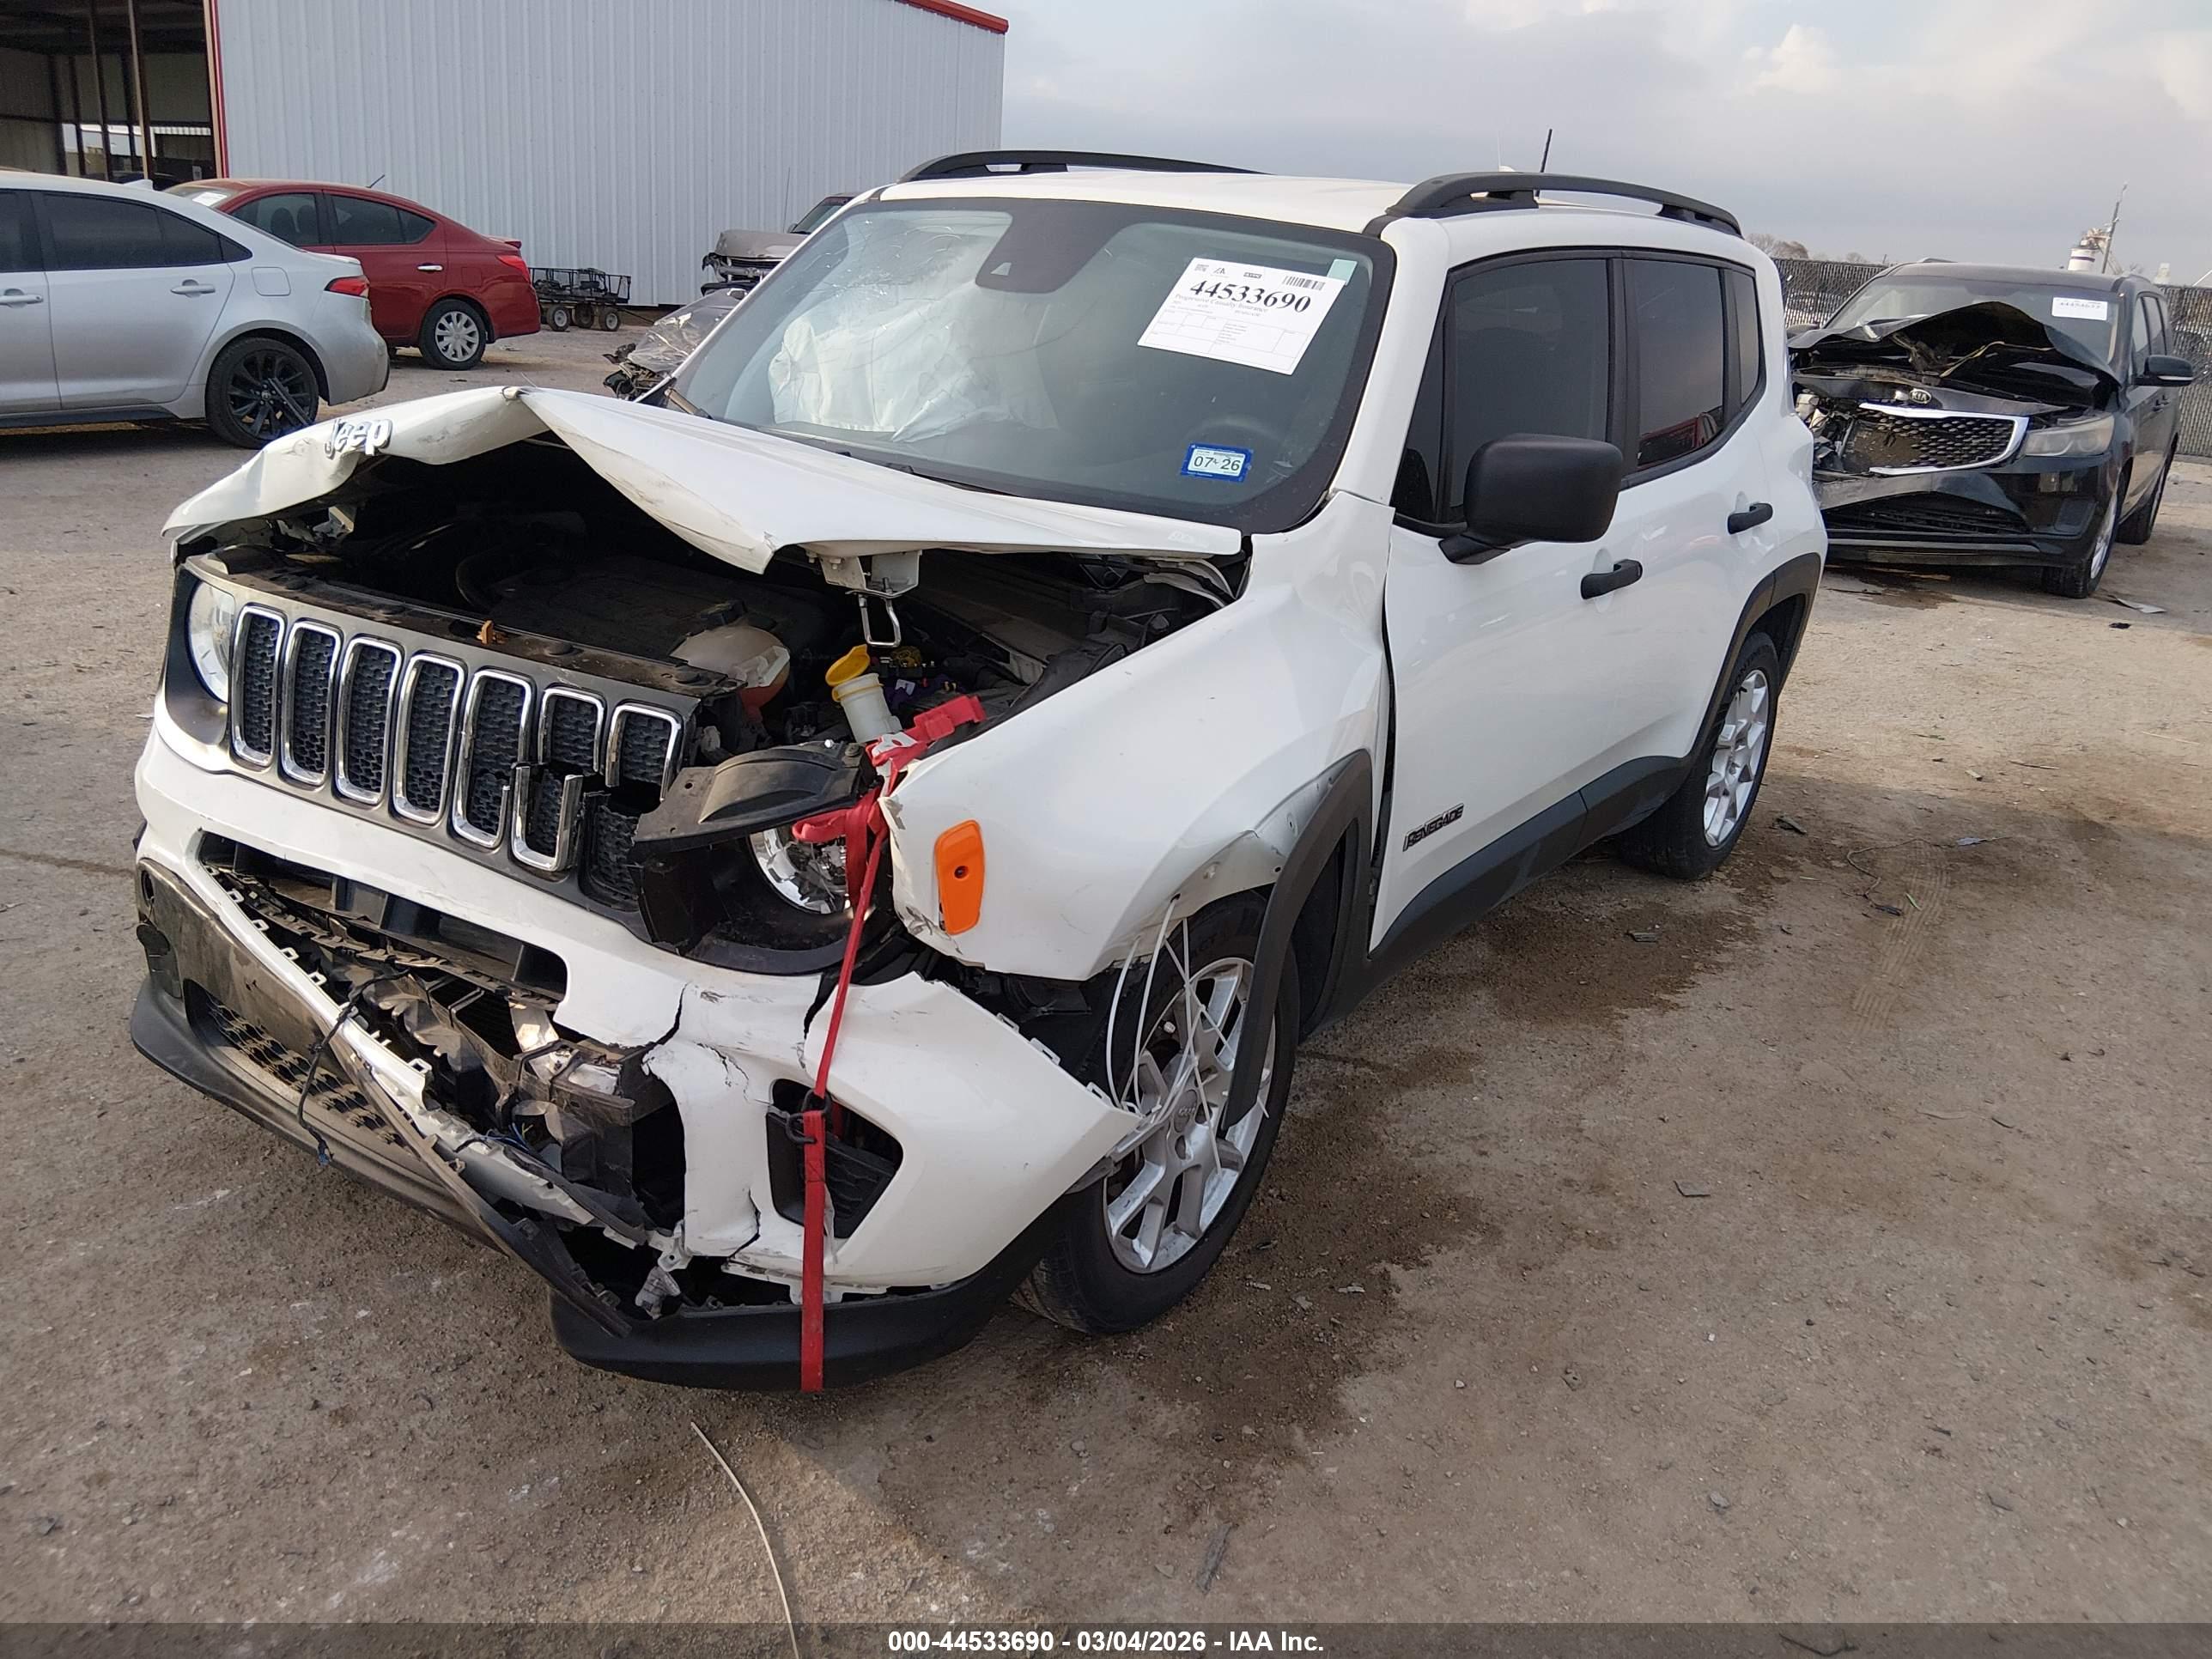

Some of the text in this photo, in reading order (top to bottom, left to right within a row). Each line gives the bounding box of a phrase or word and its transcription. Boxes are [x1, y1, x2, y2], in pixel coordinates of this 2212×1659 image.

[1189, 280, 1311, 313] 44533690
[325, 418, 393, 460] Jeep
[1194, 456, 1242, 471] 07 26
